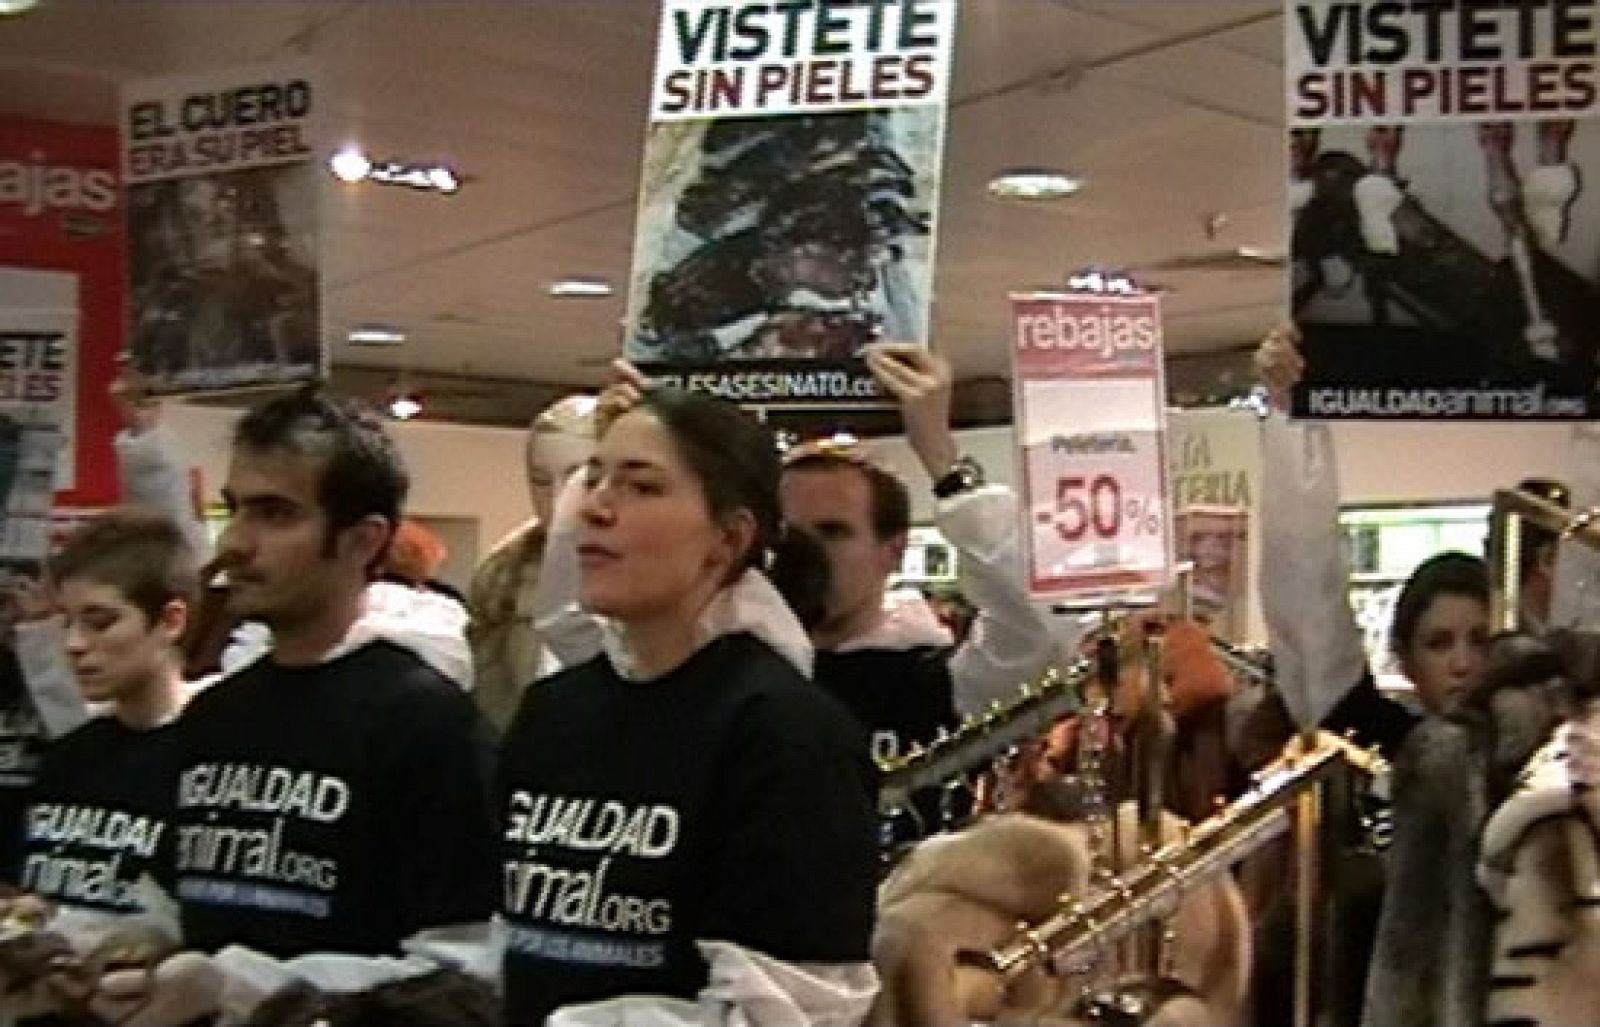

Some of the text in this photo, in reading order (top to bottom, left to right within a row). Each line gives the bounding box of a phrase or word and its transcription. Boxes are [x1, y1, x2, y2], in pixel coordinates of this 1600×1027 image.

[674, 0, 938, 63] VISTETE
[1297, 0, 1598, 64] VISTETE
[130, 80, 311, 139] EL CUERO
[661, 54, 935, 112] SIN PIELES
[1298, 63, 1597, 118] SIN PIELES
[130, 124, 313, 175] ERA SU PIEL
[1017, 304, 1154, 358] rebajas
